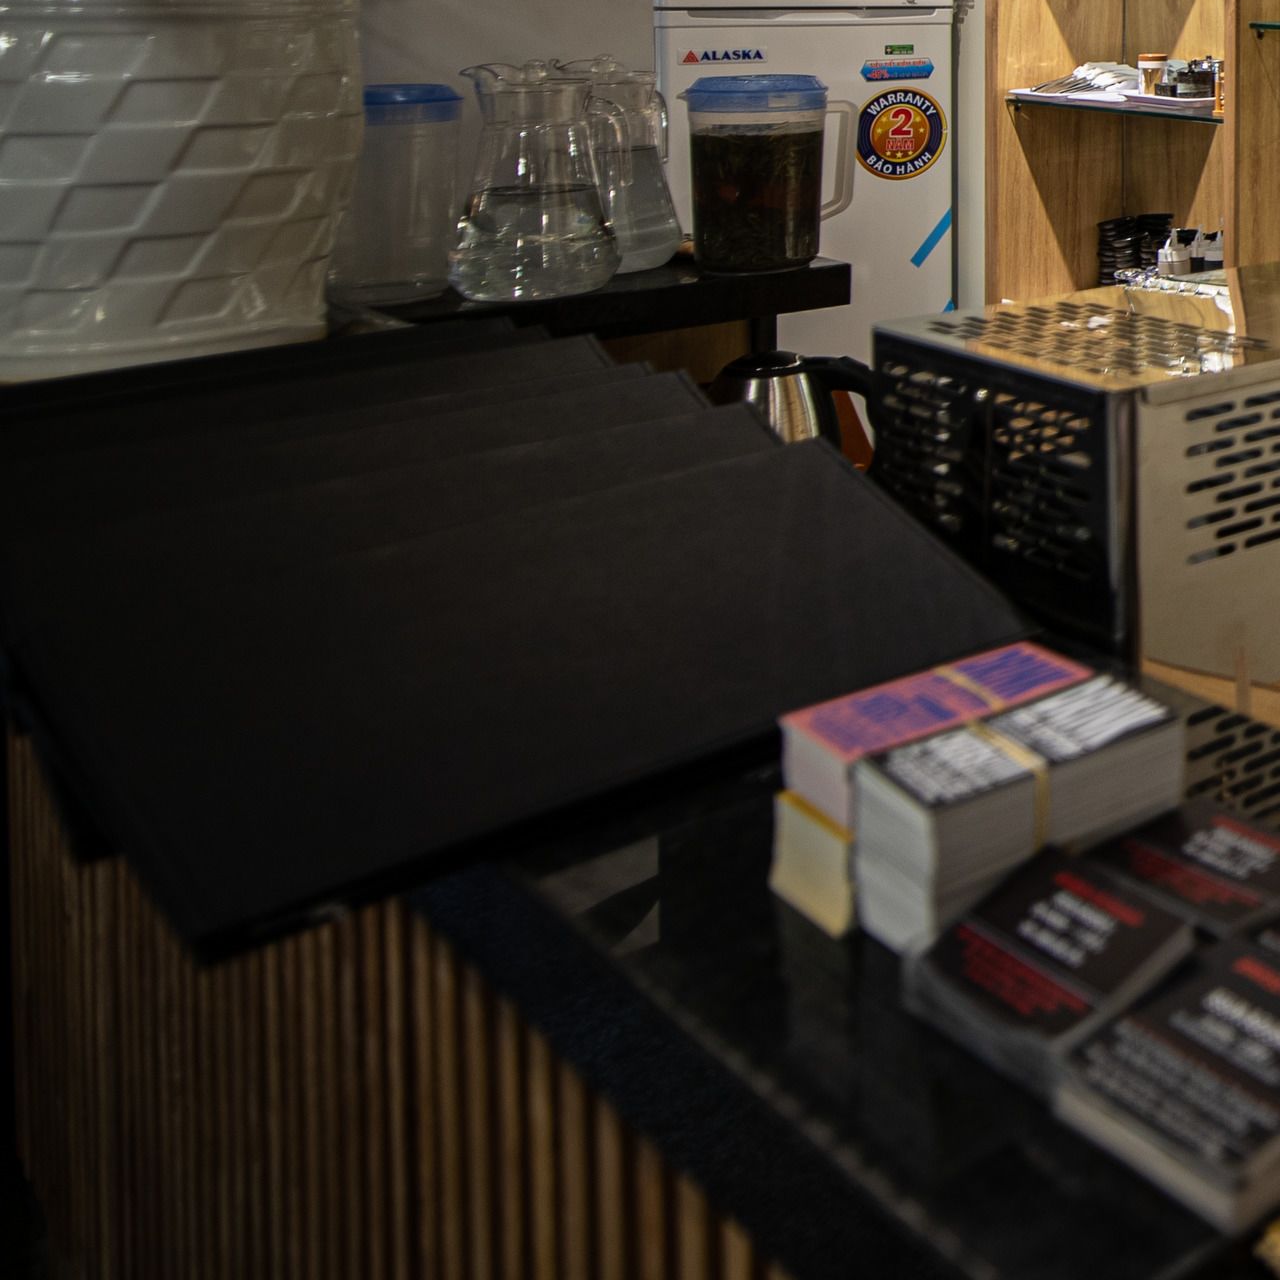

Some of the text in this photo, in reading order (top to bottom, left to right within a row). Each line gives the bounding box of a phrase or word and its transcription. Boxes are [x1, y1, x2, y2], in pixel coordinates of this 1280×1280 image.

[700, 50, 763, 61] ALASKA
[866, 92, 937, 117] WARRANTY
[888, 106, 914, 138] 2
[866, 151, 932, 175] BẢO HÀNH
